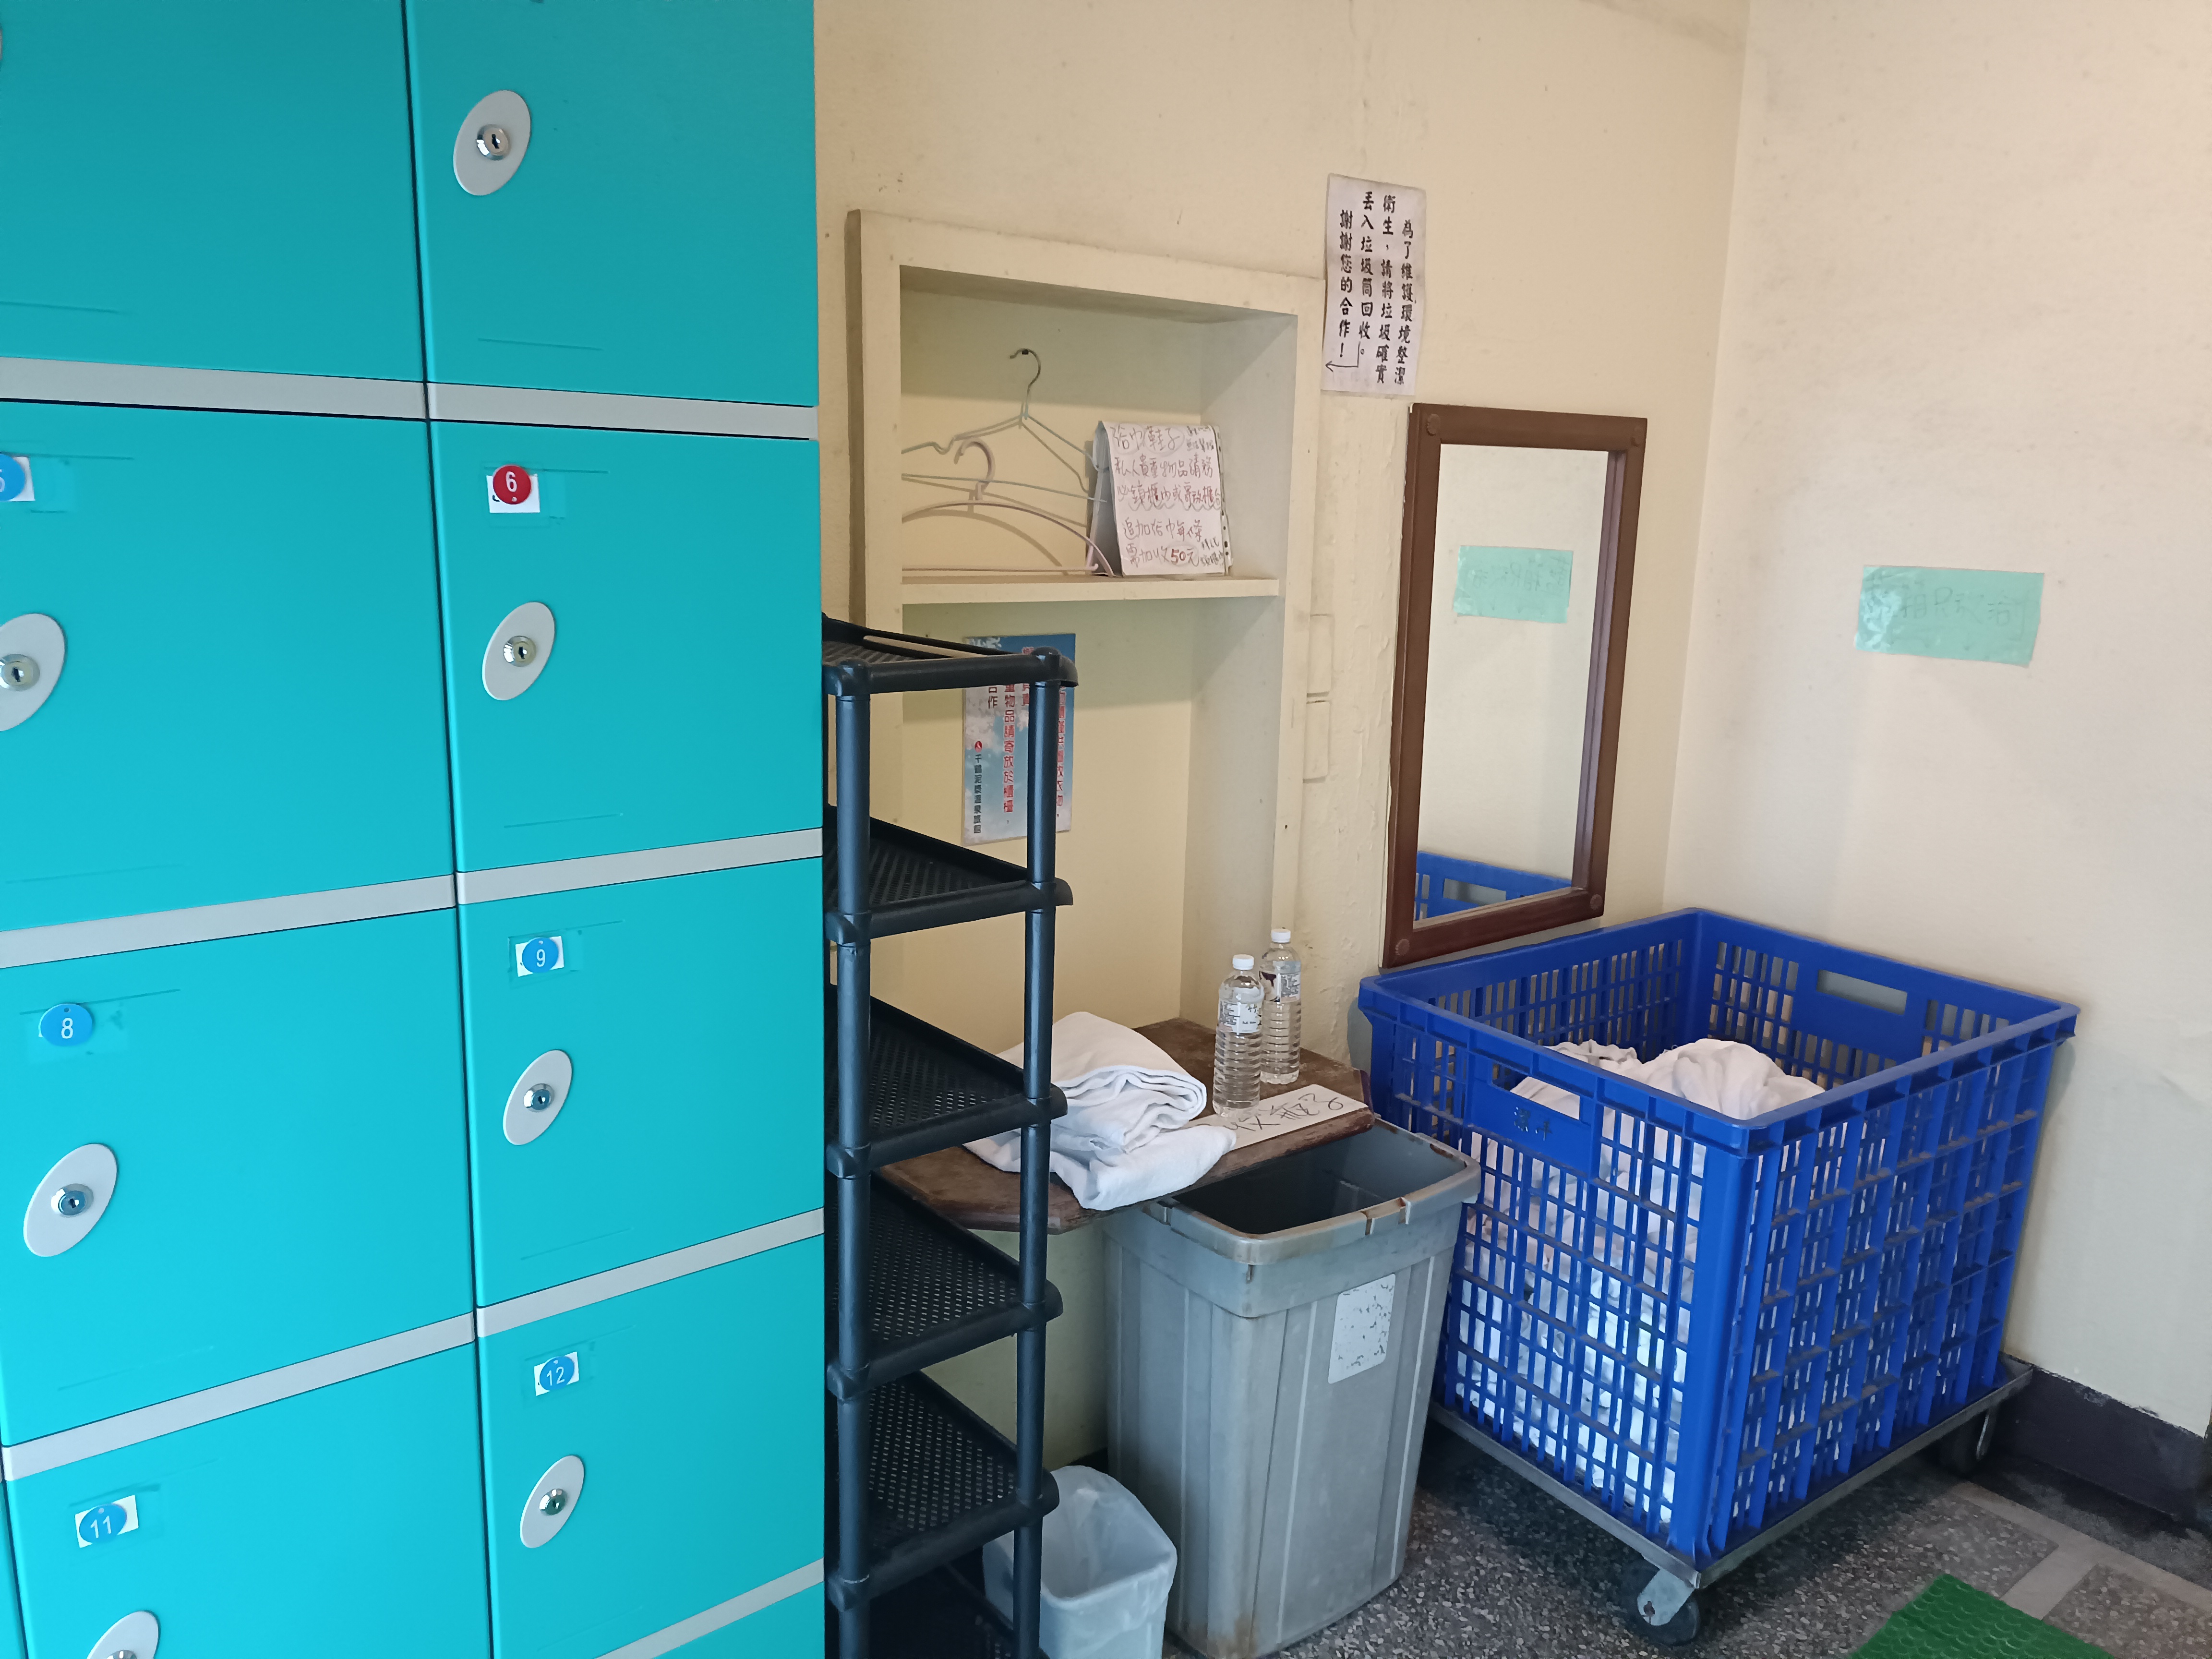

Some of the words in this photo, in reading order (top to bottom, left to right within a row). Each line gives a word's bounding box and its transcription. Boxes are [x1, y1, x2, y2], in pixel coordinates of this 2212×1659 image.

[505, 471, 517, 493] 6
[536, 949, 546, 967] 9
[61, 1018, 73, 1039] 8
[546, 1366, 565, 1386] 12
[90, 1515, 111, 1539] 11
